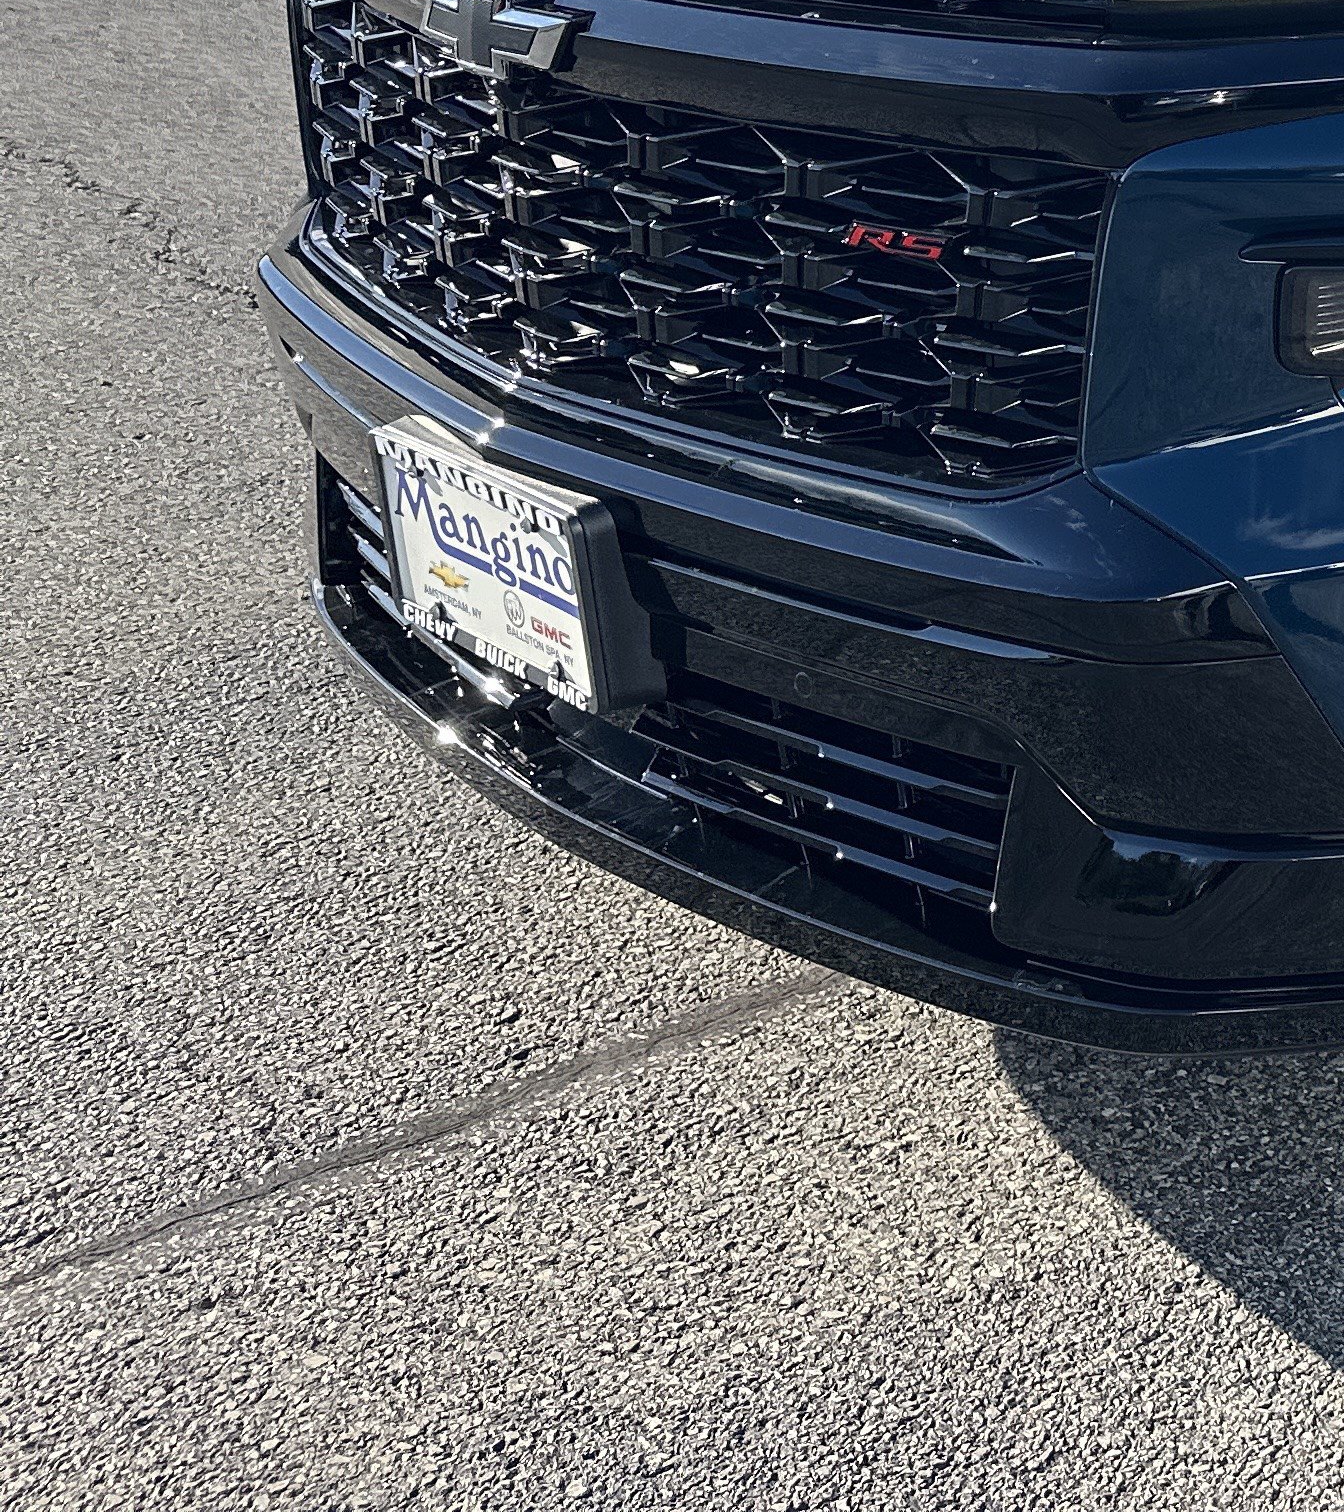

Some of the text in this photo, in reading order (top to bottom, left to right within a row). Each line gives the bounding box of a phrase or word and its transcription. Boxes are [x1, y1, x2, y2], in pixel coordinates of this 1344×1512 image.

[846, 223, 945, 261] RS
[374, 435, 562, 536] MANGINO
[394, 466, 577, 596] Mangino
[475, 607, 482, 620] NY
[531, 615, 573, 650] GMC
[402, 602, 588, 711] CHEVY BUICK GMC
[506, 623, 545, 653] BALLSTON
[564, 655, 574, 667] NY
